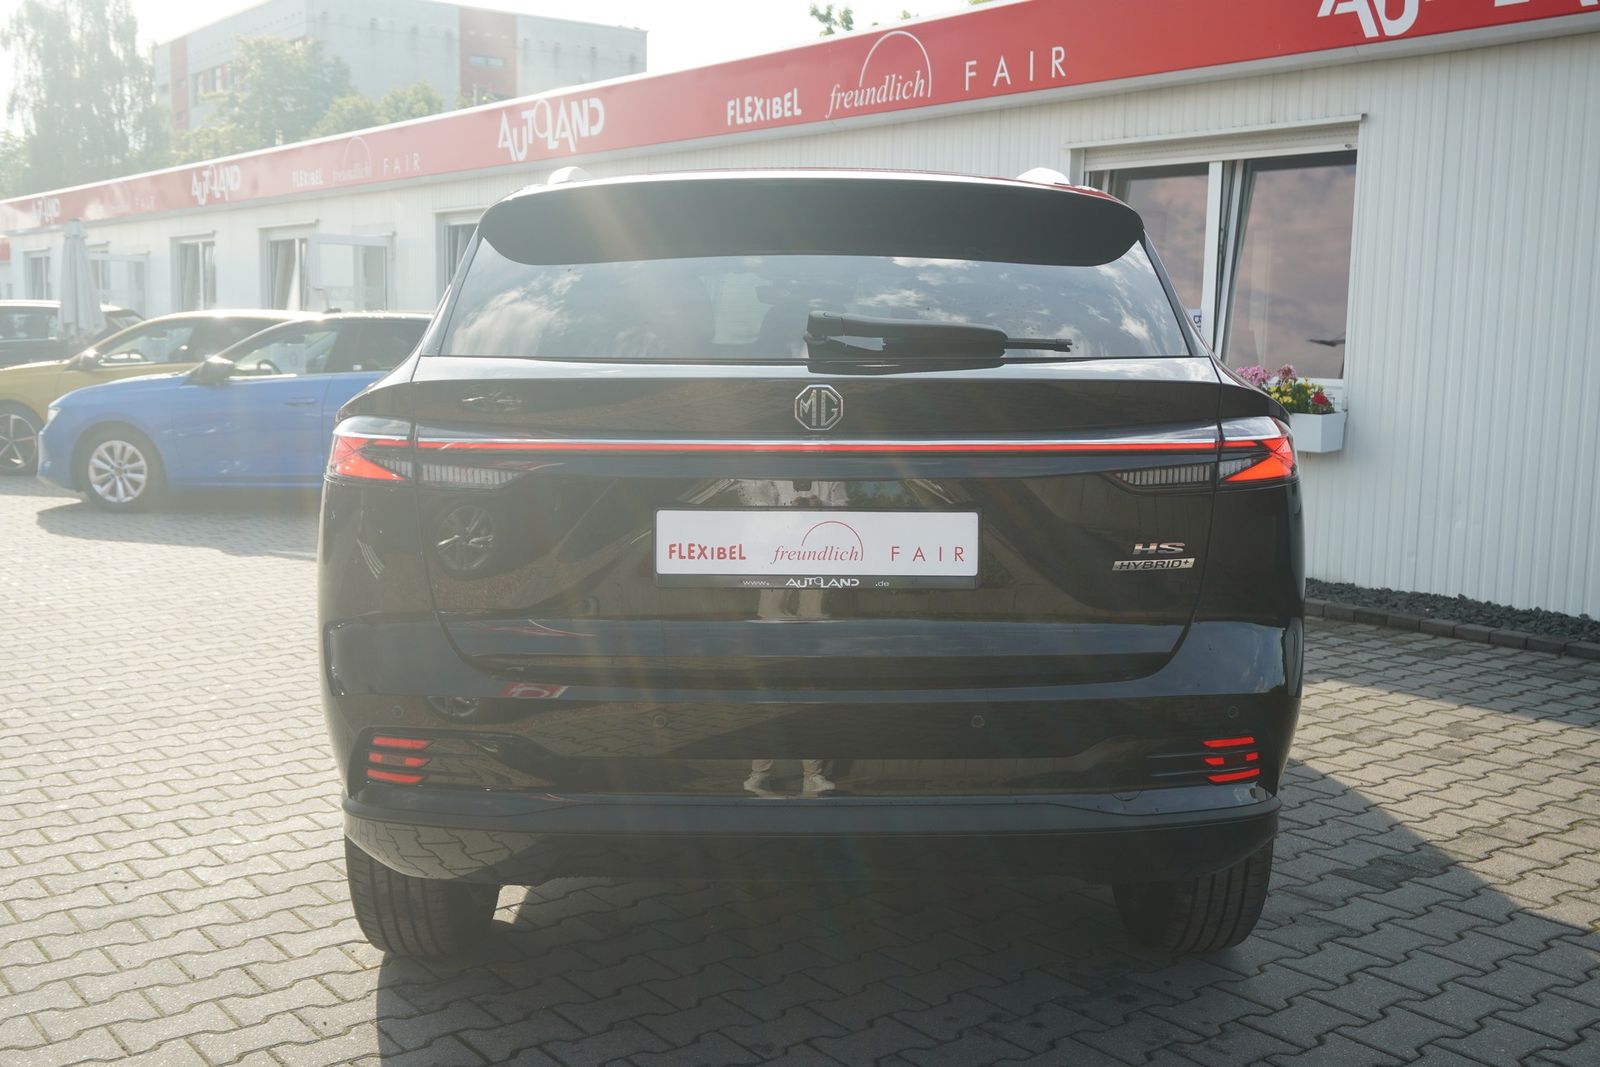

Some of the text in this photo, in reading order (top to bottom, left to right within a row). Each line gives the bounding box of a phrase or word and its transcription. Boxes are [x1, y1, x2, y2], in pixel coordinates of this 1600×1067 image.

[727, 46, 1067, 126] FLEXIBEL freundlich FAIR
[497, 98, 605, 162] AUTOLAND
[383, 152, 422, 176] FAIR
[799, 388, 839, 427] MG
[668, 543, 965, 565] FLEXIBEL freundlich FAIR
[1132, 542, 1185, 555] HS
[1119, 559, 1190, 570] HYBRID+
[785, 576, 860, 588] AUTOLAND
